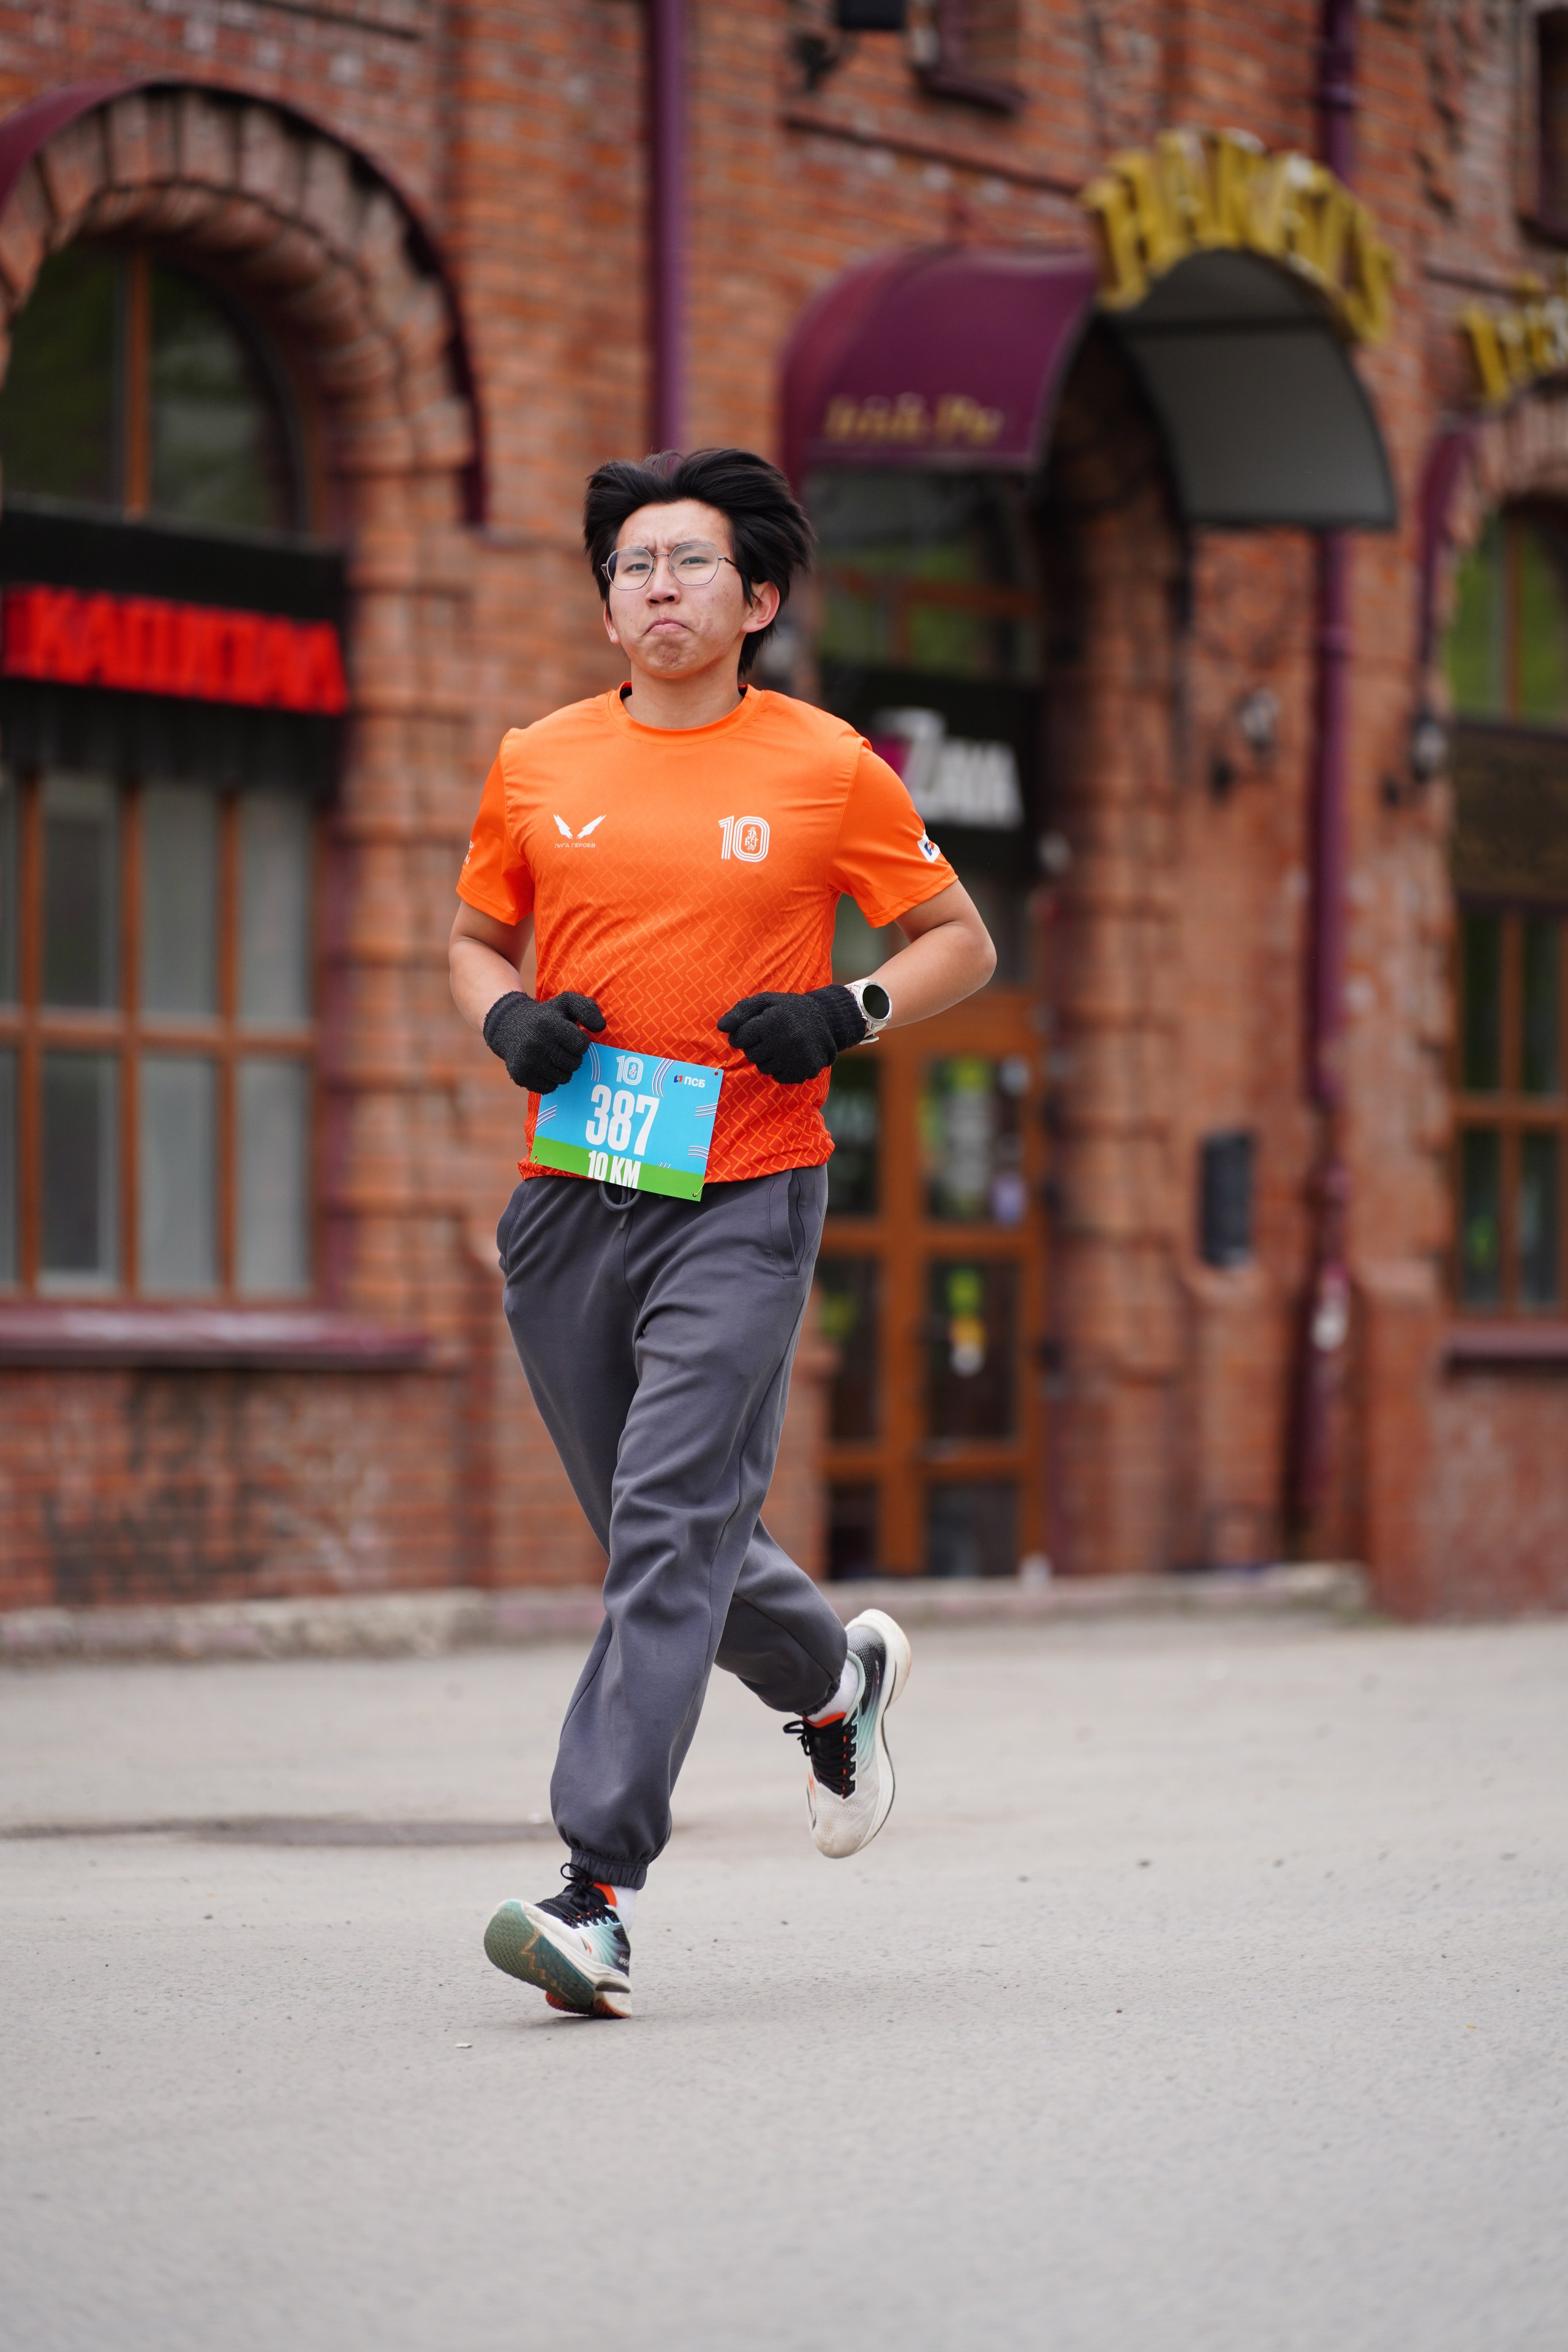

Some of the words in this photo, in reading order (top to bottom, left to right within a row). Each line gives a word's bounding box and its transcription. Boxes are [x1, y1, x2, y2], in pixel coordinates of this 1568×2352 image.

[718, 815, 770, 862] 10
[616, 1055, 644, 1085] 10
[684, 1076, 706, 1088] ПСБ
[586, 1084, 660, 1156] 387
[587, 1150, 608, 1181] 10
